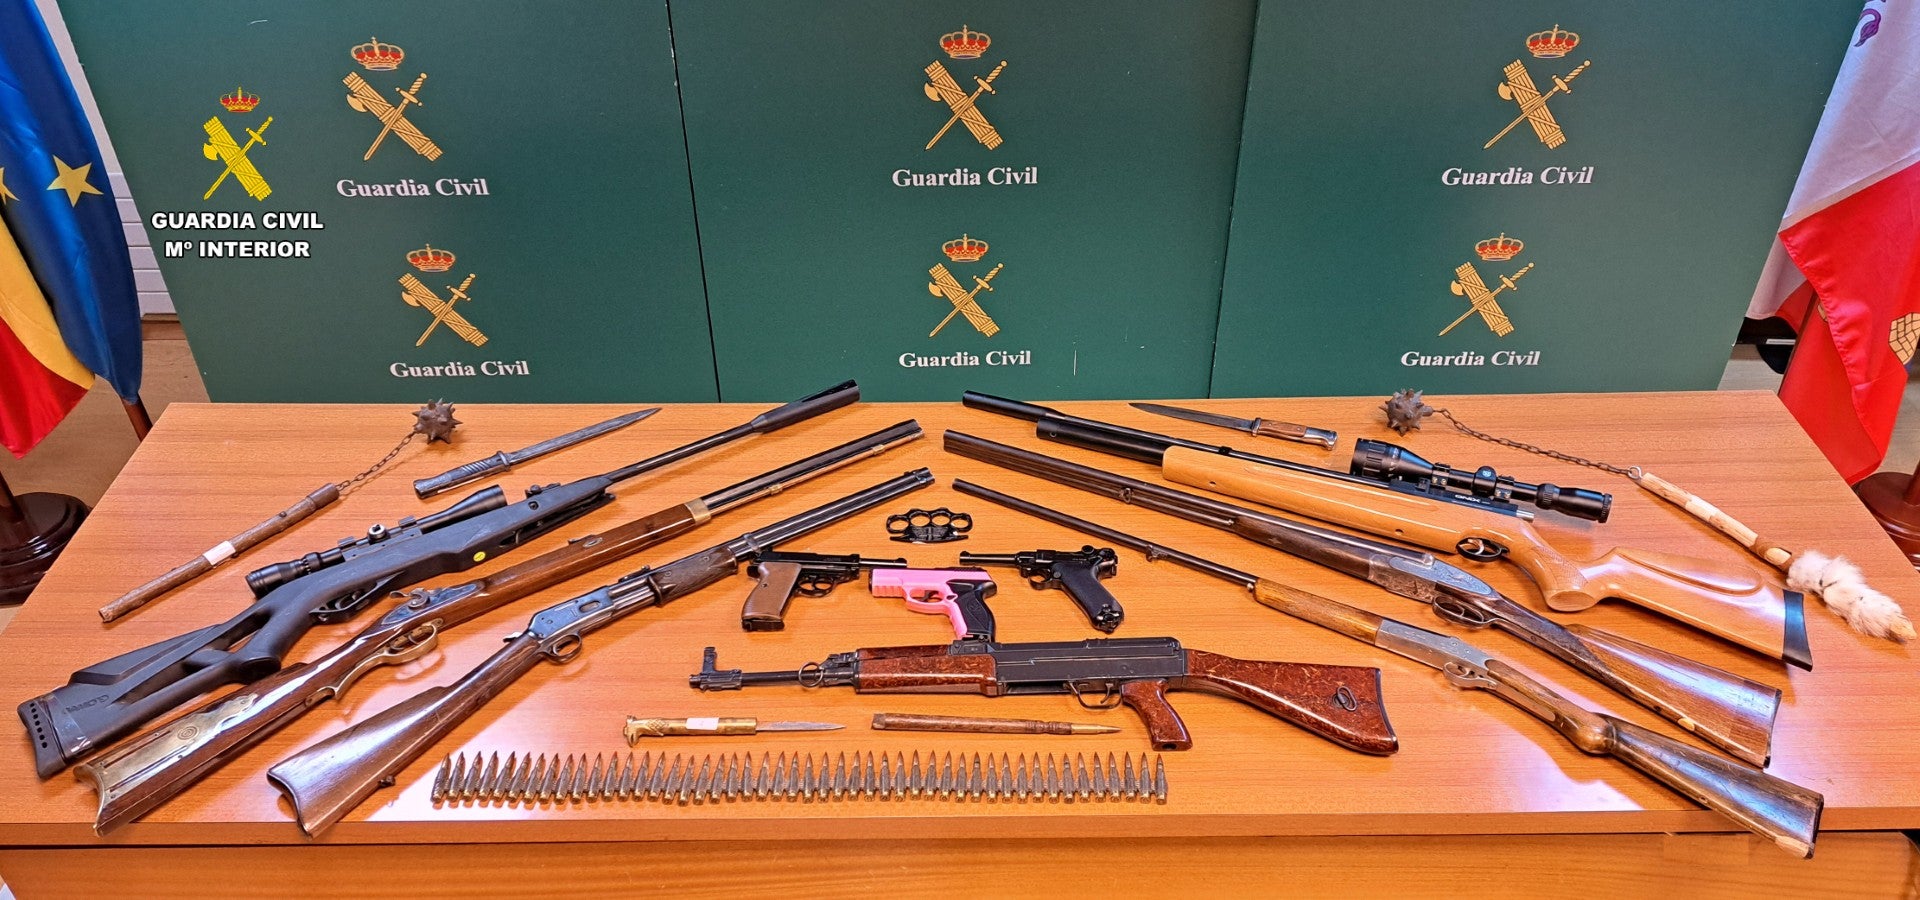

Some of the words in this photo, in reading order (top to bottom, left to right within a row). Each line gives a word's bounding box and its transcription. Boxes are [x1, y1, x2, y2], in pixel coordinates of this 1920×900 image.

[892, 167, 981, 187] Guardia
[987, 166, 1038, 185] Civil
[1441, 166, 1533, 186] Guardia
[1540, 166, 1595, 185] Civil
[336, 179, 431, 198] Guardia
[436, 178, 490, 196] Civil
[898, 351, 980, 368] Guardia
[985, 350, 1032, 366] Civil
[1400, 350, 1485, 367] Guardia
[1490, 350, 1541, 366] Civil
[389, 361, 477, 378] Guardia
[481, 360, 530, 376] Civil
